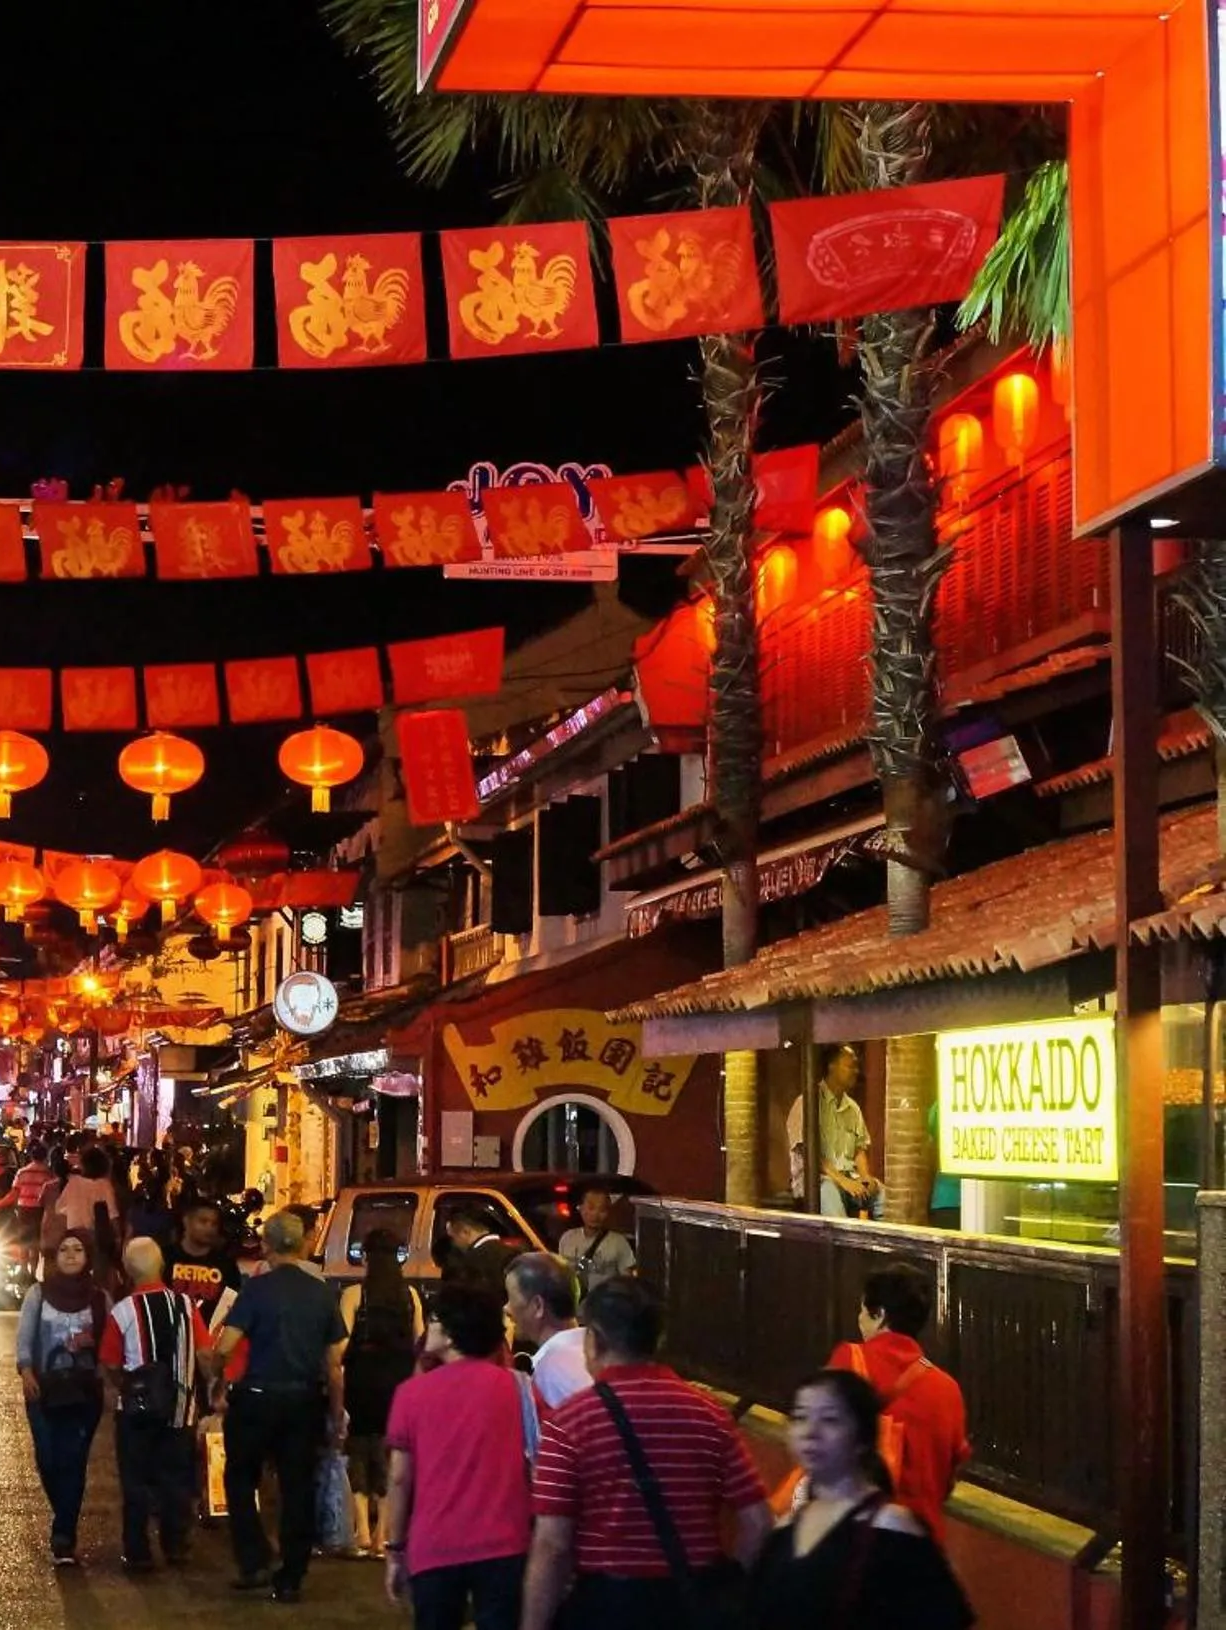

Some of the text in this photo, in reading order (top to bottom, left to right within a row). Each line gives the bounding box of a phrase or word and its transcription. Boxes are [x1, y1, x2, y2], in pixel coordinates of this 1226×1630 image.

[950, 1035, 1102, 1113] HOKKAIDO
[951, 1126, 1105, 1165] BAKED CHEESE TART
[172, 1263, 223, 1284] RETRO
